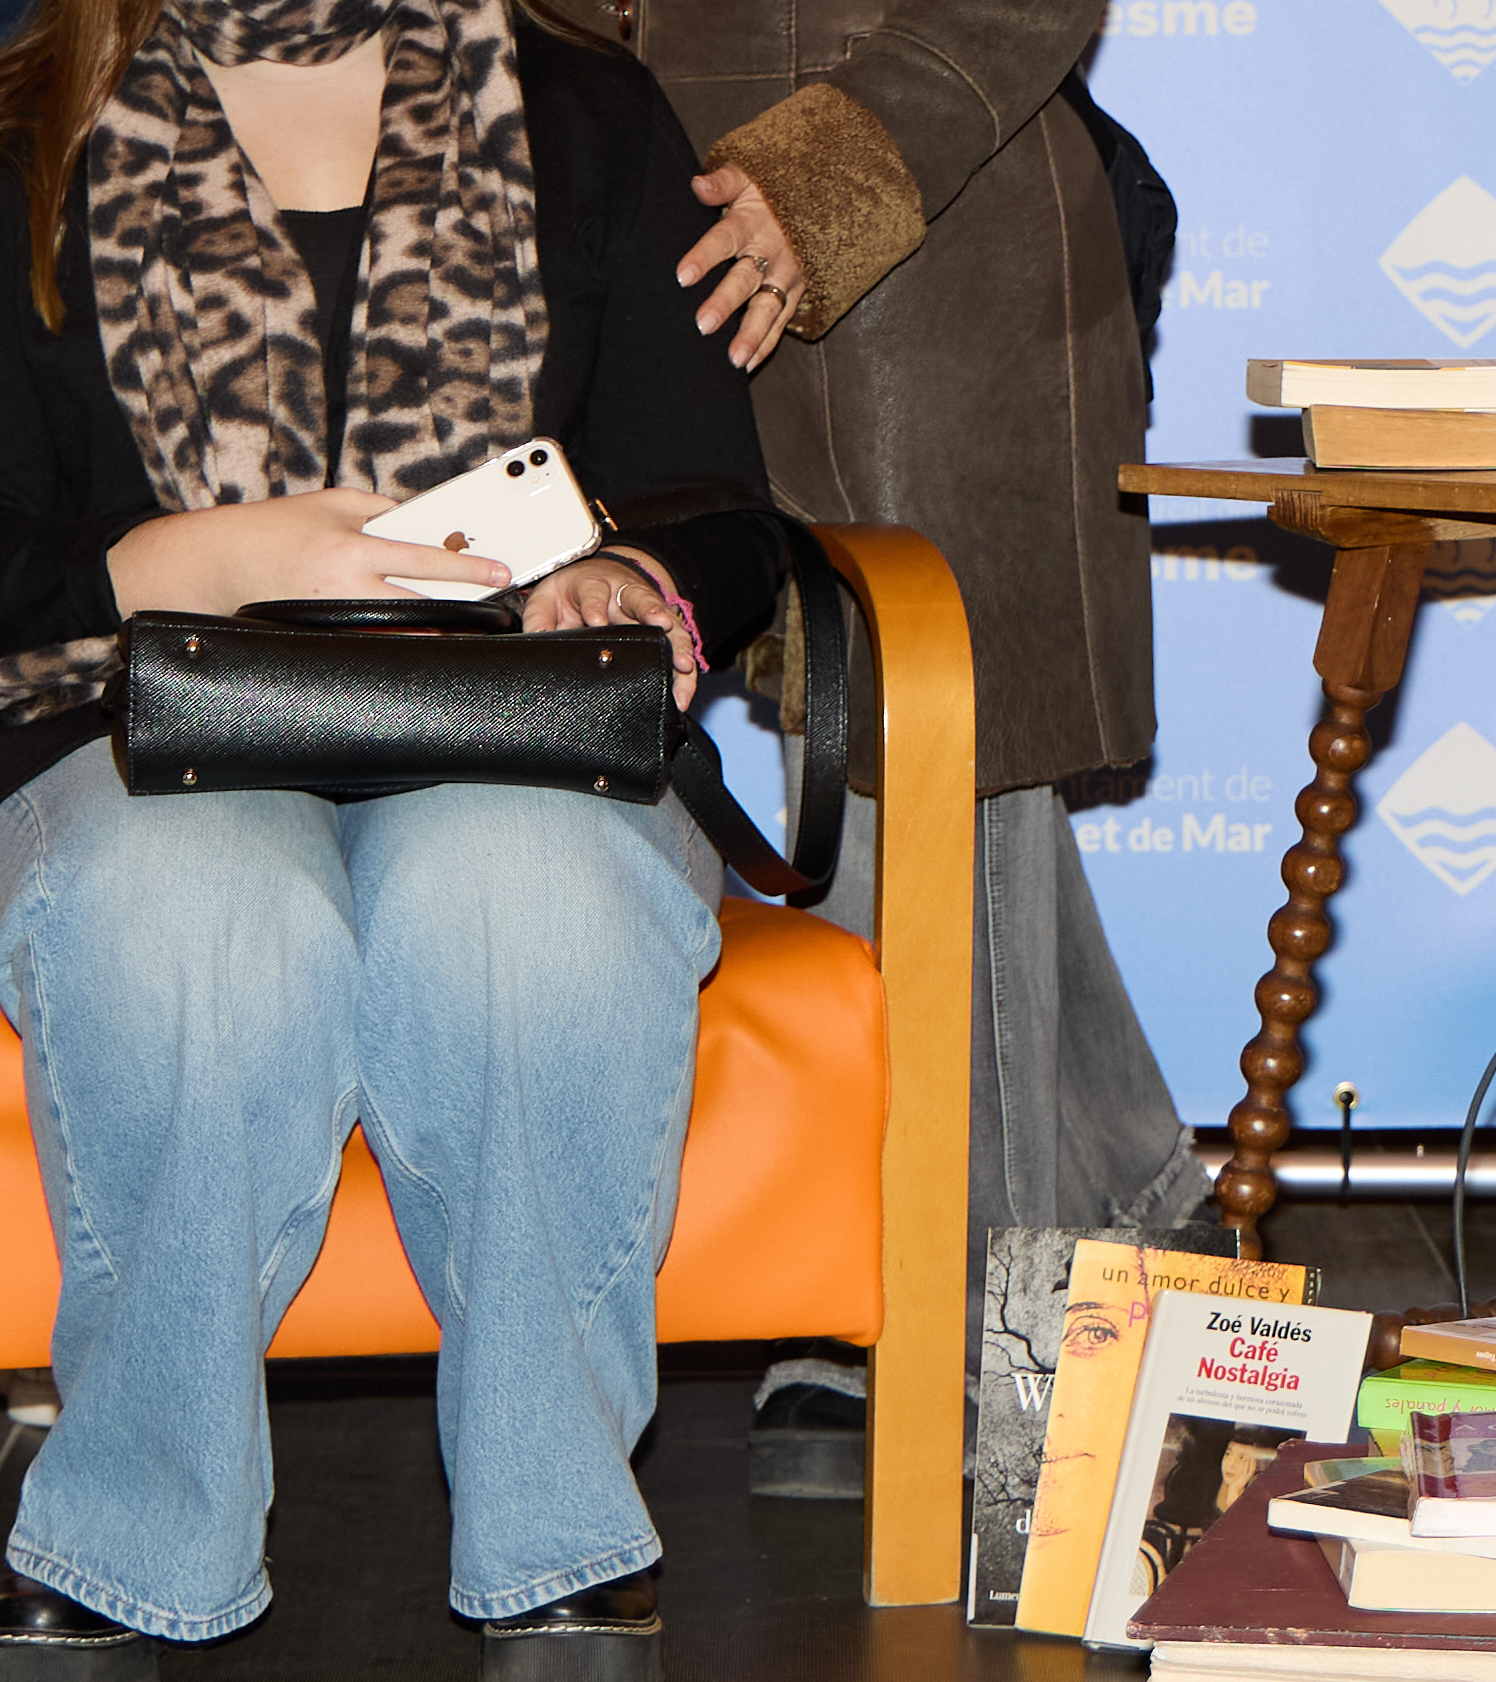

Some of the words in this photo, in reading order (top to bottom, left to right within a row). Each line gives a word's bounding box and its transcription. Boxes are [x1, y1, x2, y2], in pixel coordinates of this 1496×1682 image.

[1095, 0, 1258, 37] esme
[1179, 271, 1270, 309] Mar
[1102, 1267, 1129, 1285] un
[1138, 1270, 1200, 1292] amor
[1209, 1274, 1269, 1299] dulce
[1278, 1286, 1291, 1304] y
[1206, 1311, 1242, 1333] Zoé
[1250, 1316, 1312, 1343] Valdés
[1229, 1336, 1279, 1363] Café
[1197, 1356, 1300, 1392] Nostalgia
